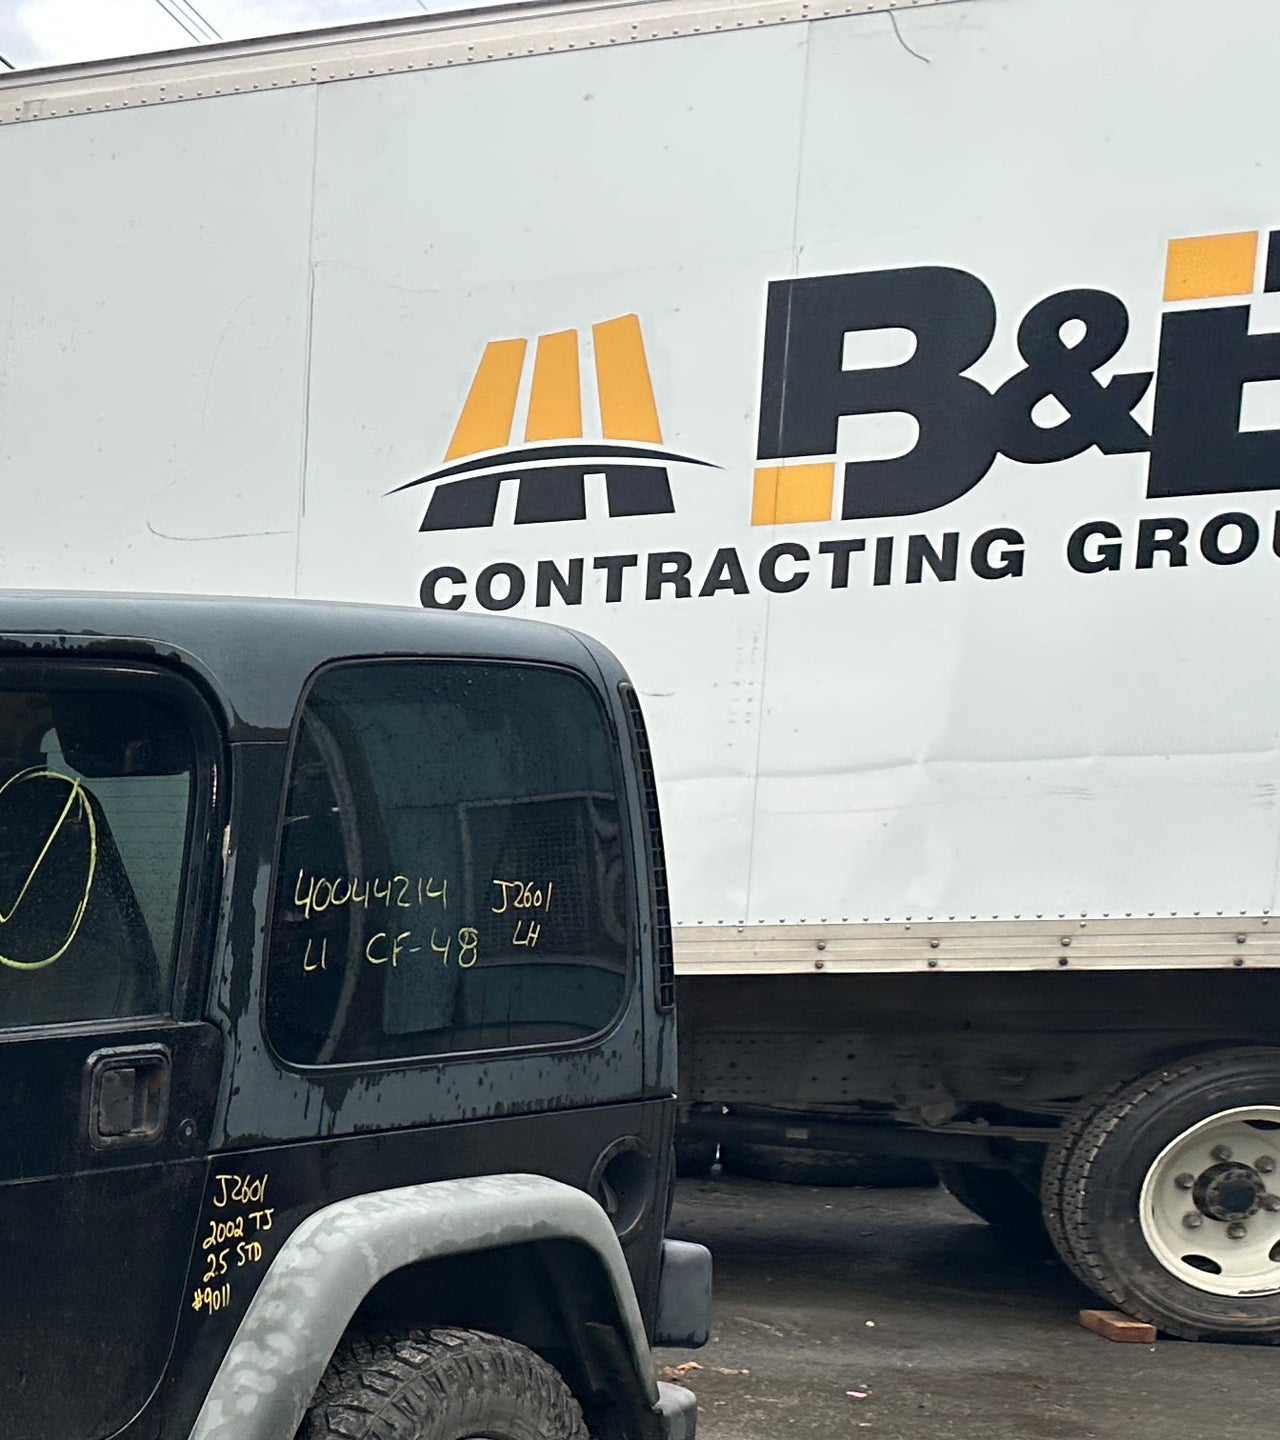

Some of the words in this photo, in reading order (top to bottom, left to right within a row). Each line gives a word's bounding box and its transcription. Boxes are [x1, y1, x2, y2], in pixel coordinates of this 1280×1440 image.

[419, 527, 1025, 611] CONTRACTING
[1067, 510, 1280, 574] GRO
[294, 868, 448, 919] 40044214
[491, 879, 553, 914] J2601
[213, 1173, 269, 1208] J2601
[202, 1216, 244, 1249] 2002
[248, 1208, 275, 1231] TJ
[236, 1241, 262, 1267] STD
